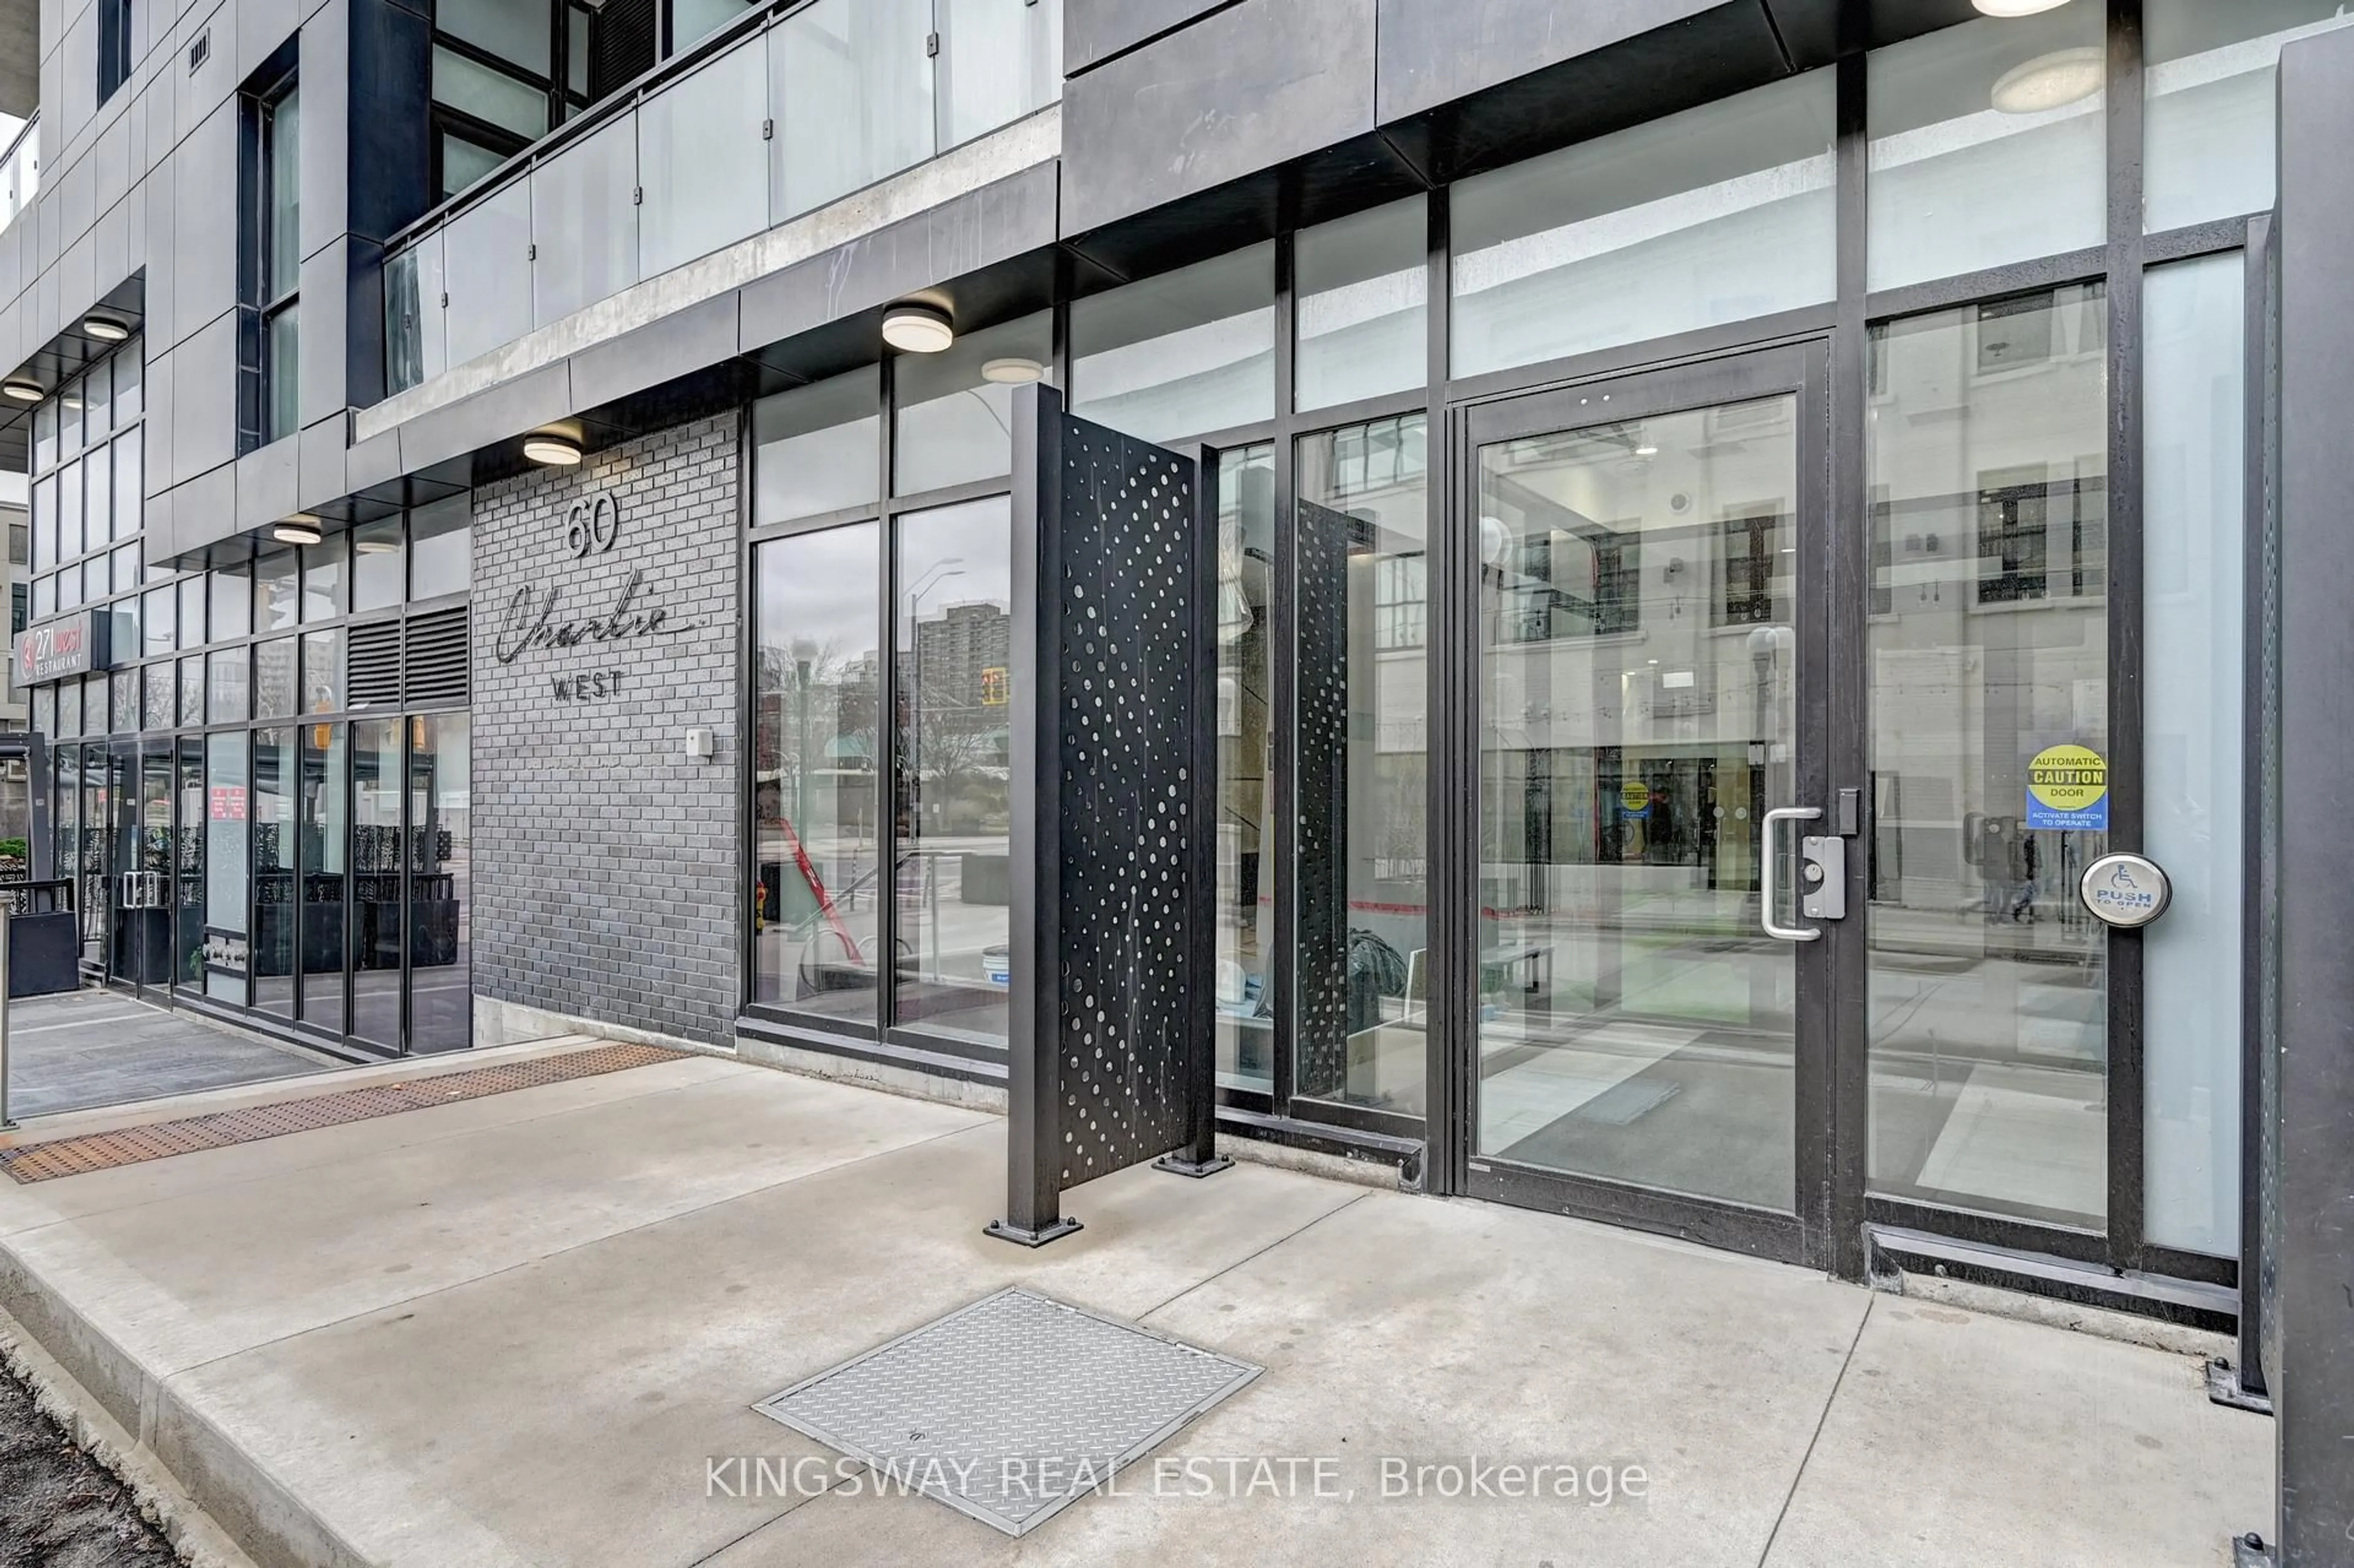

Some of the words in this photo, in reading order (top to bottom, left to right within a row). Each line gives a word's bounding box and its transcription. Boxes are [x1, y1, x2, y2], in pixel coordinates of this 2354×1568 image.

[565, 490, 618, 558] 60
[497, 568, 696, 663] Charlie
[36, 627, 54, 660] 271
[36, 653, 82, 676] RESTAURANT
[552, 671, 624, 701] WEST
[2034, 771, 2103, 784] CAUTION
[2097, 890, 2151, 902] PUSH
